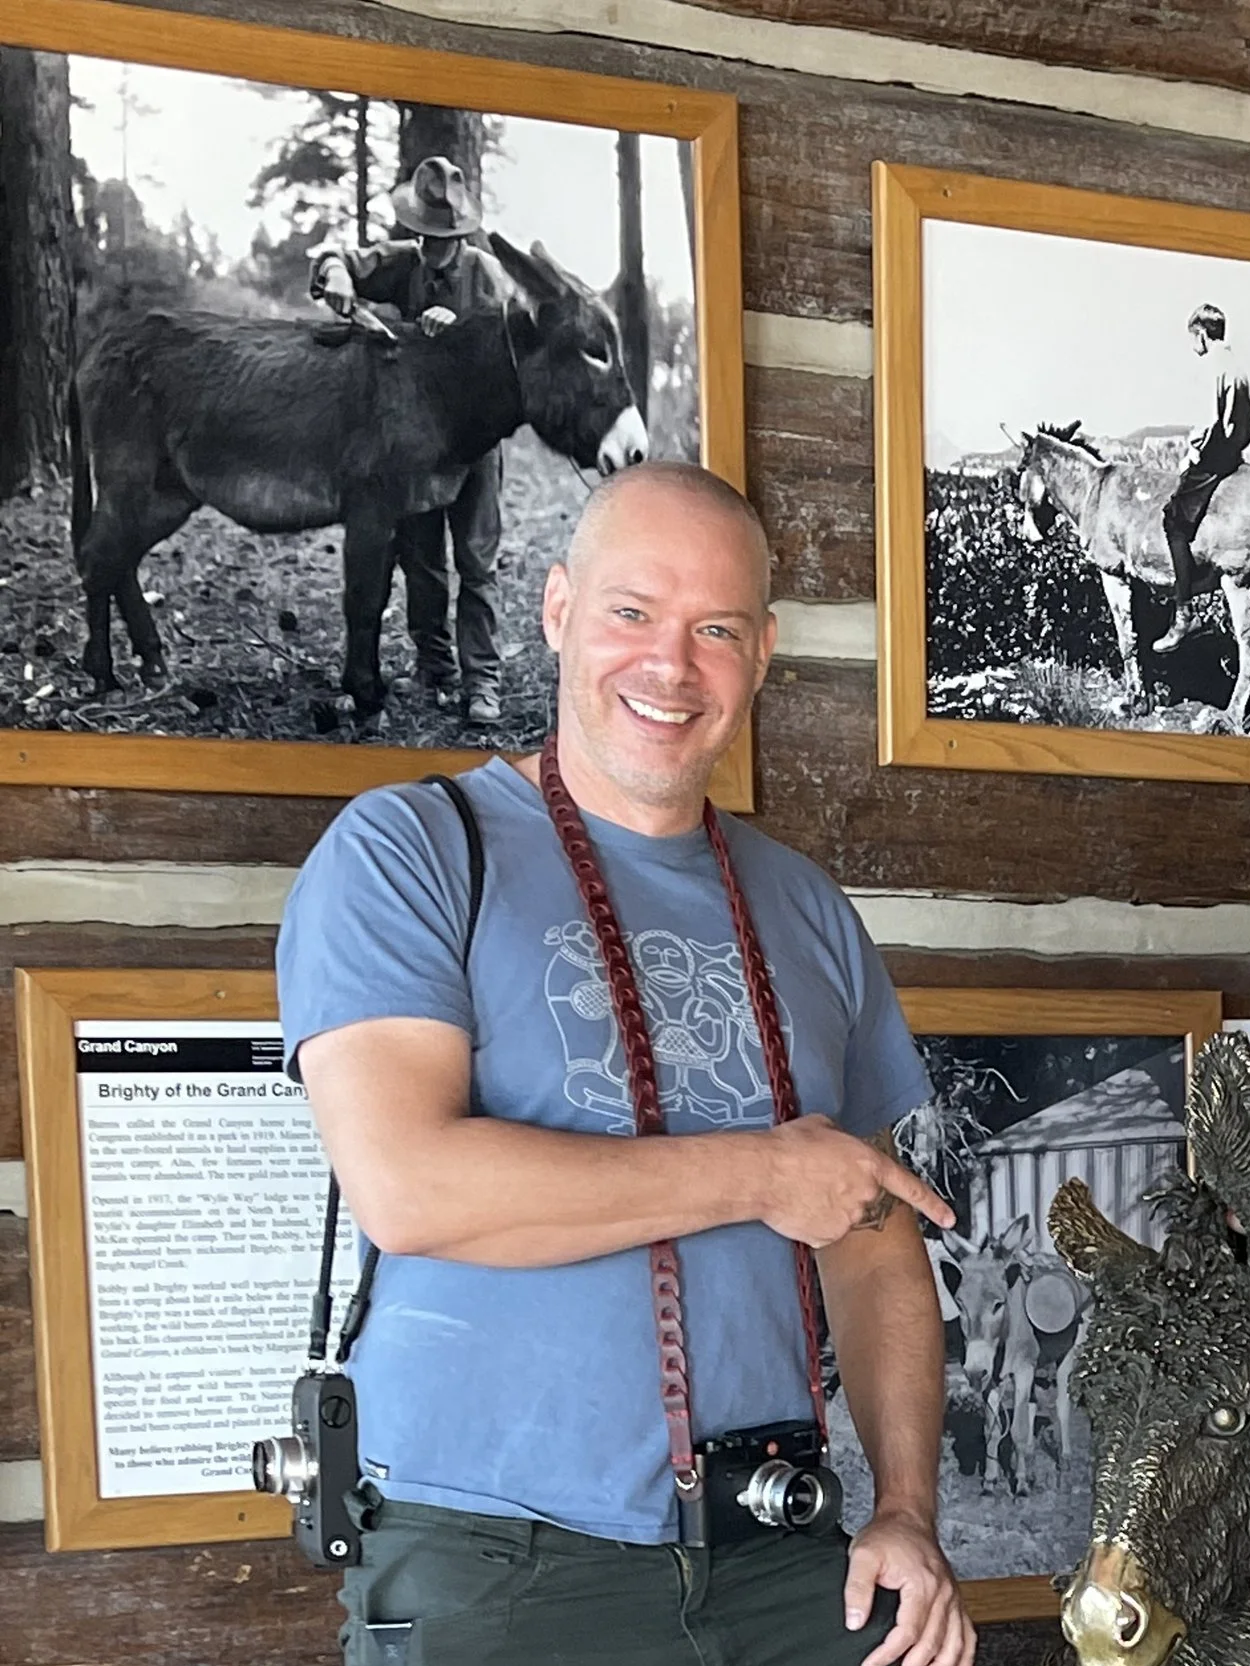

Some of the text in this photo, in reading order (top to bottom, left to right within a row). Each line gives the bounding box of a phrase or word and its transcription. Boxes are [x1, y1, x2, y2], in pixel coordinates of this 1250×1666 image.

[78, 1039, 177, 1056] Grand Canyon
[99, 1083, 159, 1101] Brighty
[165, 1082, 181, 1097] of
[186, 1082, 212, 1097] the
[217, 1081, 266, 1097] Grand
